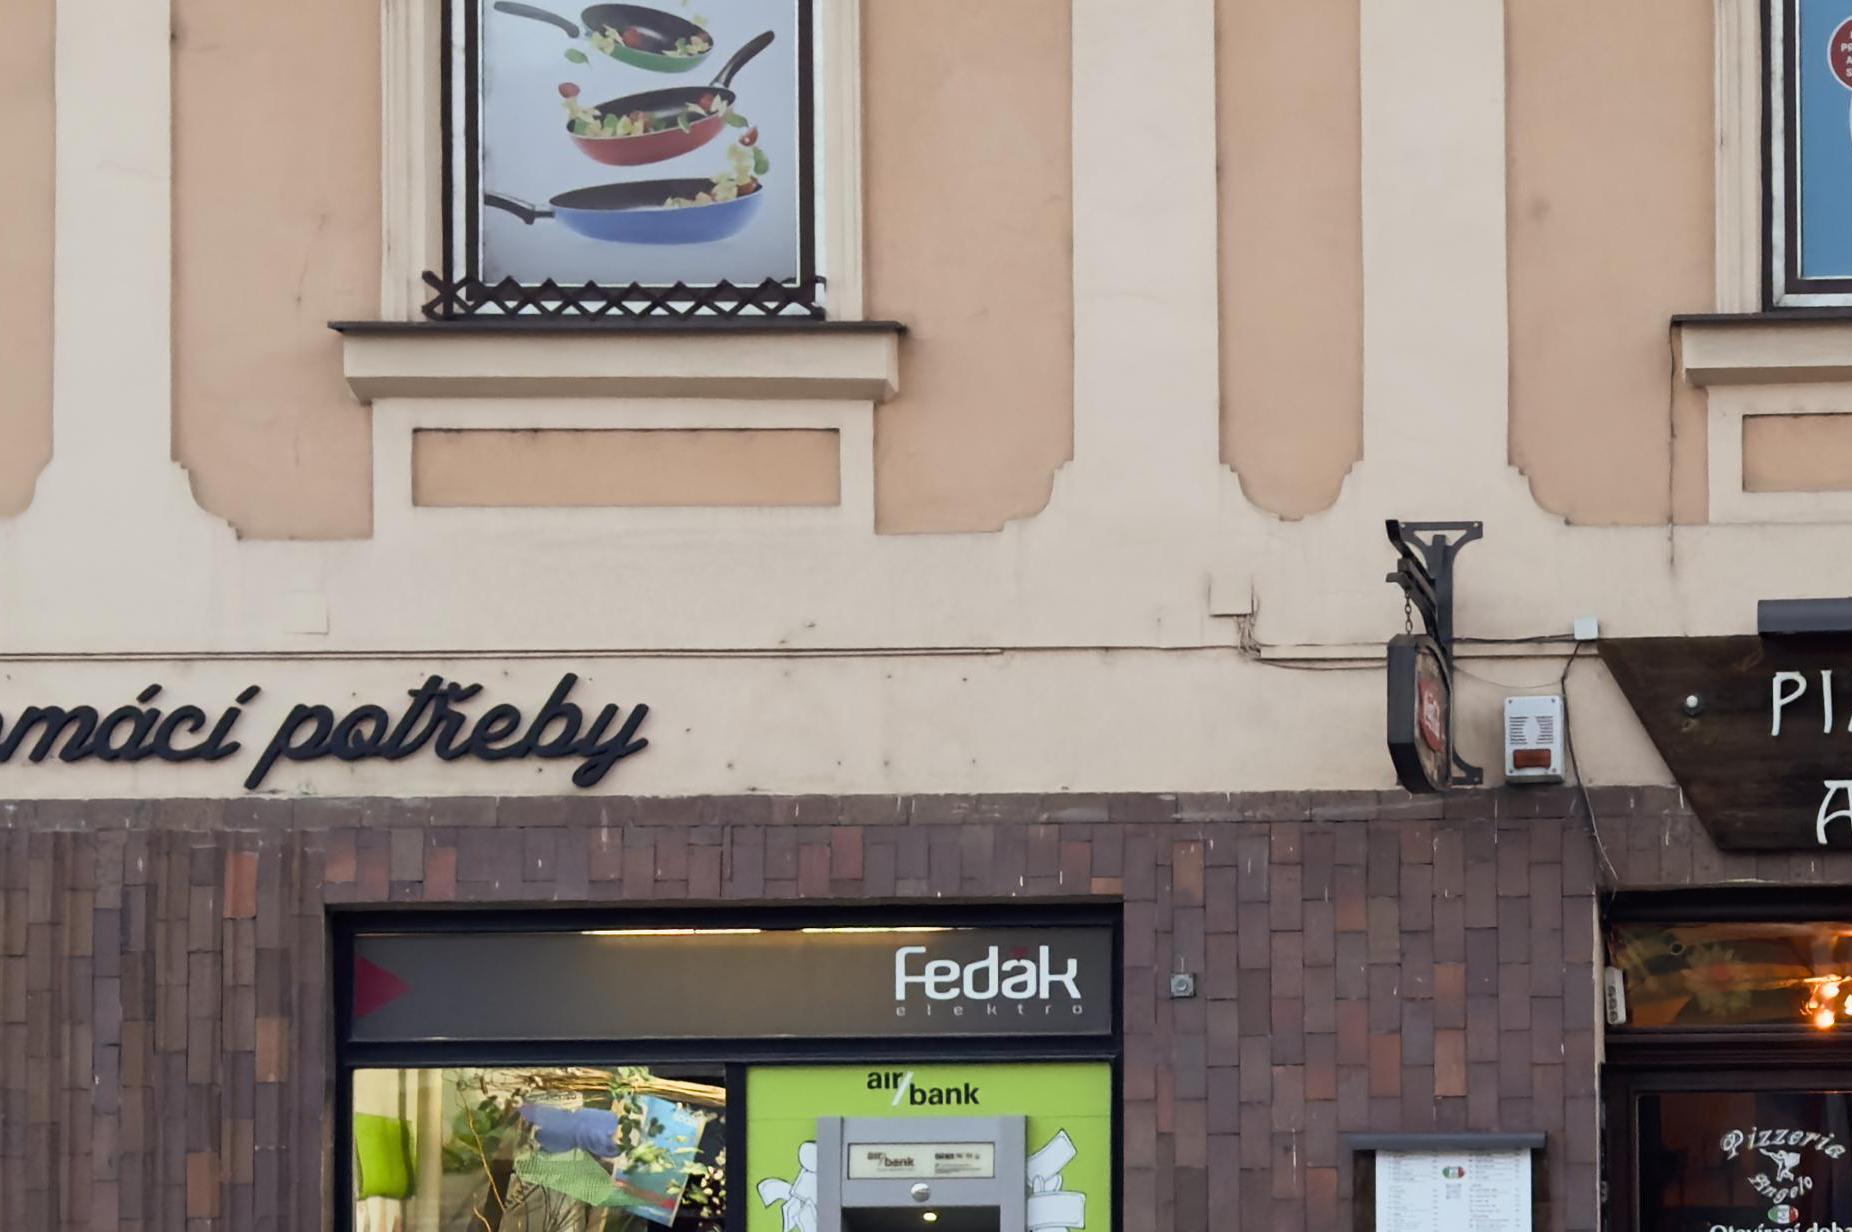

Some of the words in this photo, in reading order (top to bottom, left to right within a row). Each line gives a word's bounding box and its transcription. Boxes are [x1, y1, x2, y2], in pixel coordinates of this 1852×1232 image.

[1846, 67, 1852, 77] S
[0, 684, 261, 763] mácí
[243, 672, 650, 789] potřeby
